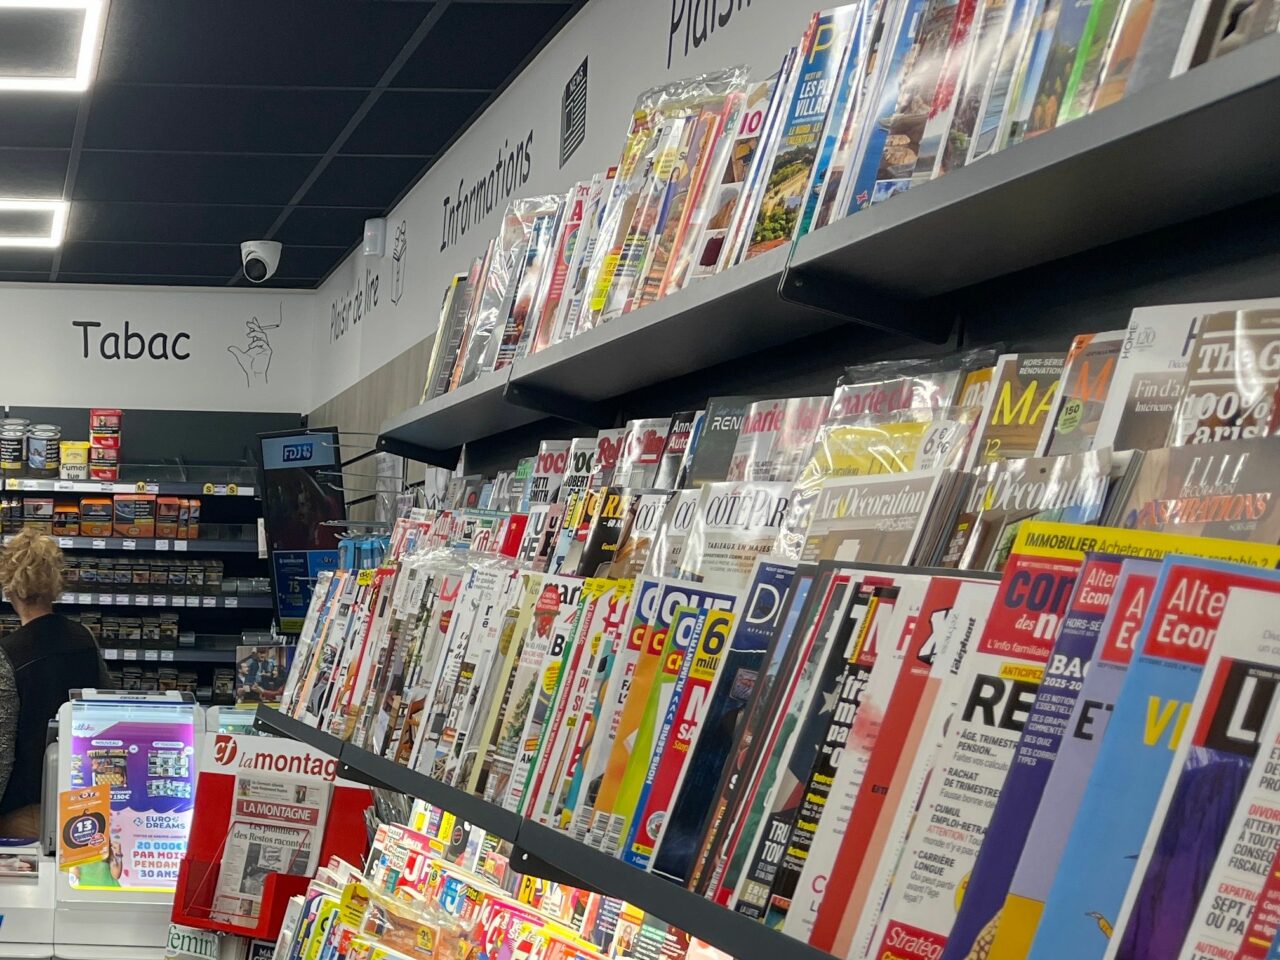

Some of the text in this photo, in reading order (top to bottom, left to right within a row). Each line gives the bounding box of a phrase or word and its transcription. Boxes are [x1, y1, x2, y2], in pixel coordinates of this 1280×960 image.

[440, 130, 534, 253] Informations
[329, 274, 380, 344] Plaisir de lire
[72, 320, 191, 360] Tabac
[1122, 321, 1138, 359] HOME
[1023, 358, 1064, 367] HORS-SÉRIE
[1064, 404, 1080, 416] 150
[284, 447, 302, 460] FDJ
[61, 464, 87, 472] Fumer
[533, 477, 549, 488] PATTI
[1024, 532, 1097, 553] IMMOBILIER
[1099, 538, 1143, 558] Acheter
[1014, 616, 1036, 632] des
[676, 614, 705, 693] ALIMENTATION
[1012, 642, 1049, 657] familiale
[1002, 666, 1044, 680] ANTICIPEZ
[254, 753, 339, 782] montag
[947, 768, 979, 781] RACHAT
[944, 778, 955, 788] DE
[243, 802, 311, 821] LA MONTAGNE
[935, 804, 961, 818] CUMUL
[76, 820, 92, 832] 13
[931, 815, 987, 835] EMPLOI-RETRA
[234, 831, 311, 849] des Restos racontent
[918, 851, 955, 867] CARRIÈRE
[157, 870, 178, 878] ANS
[914, 862, 944, 876] LONGUE
[1212, 894, 1242, 916] SEPT
[166, 924, 217, 957] femin
